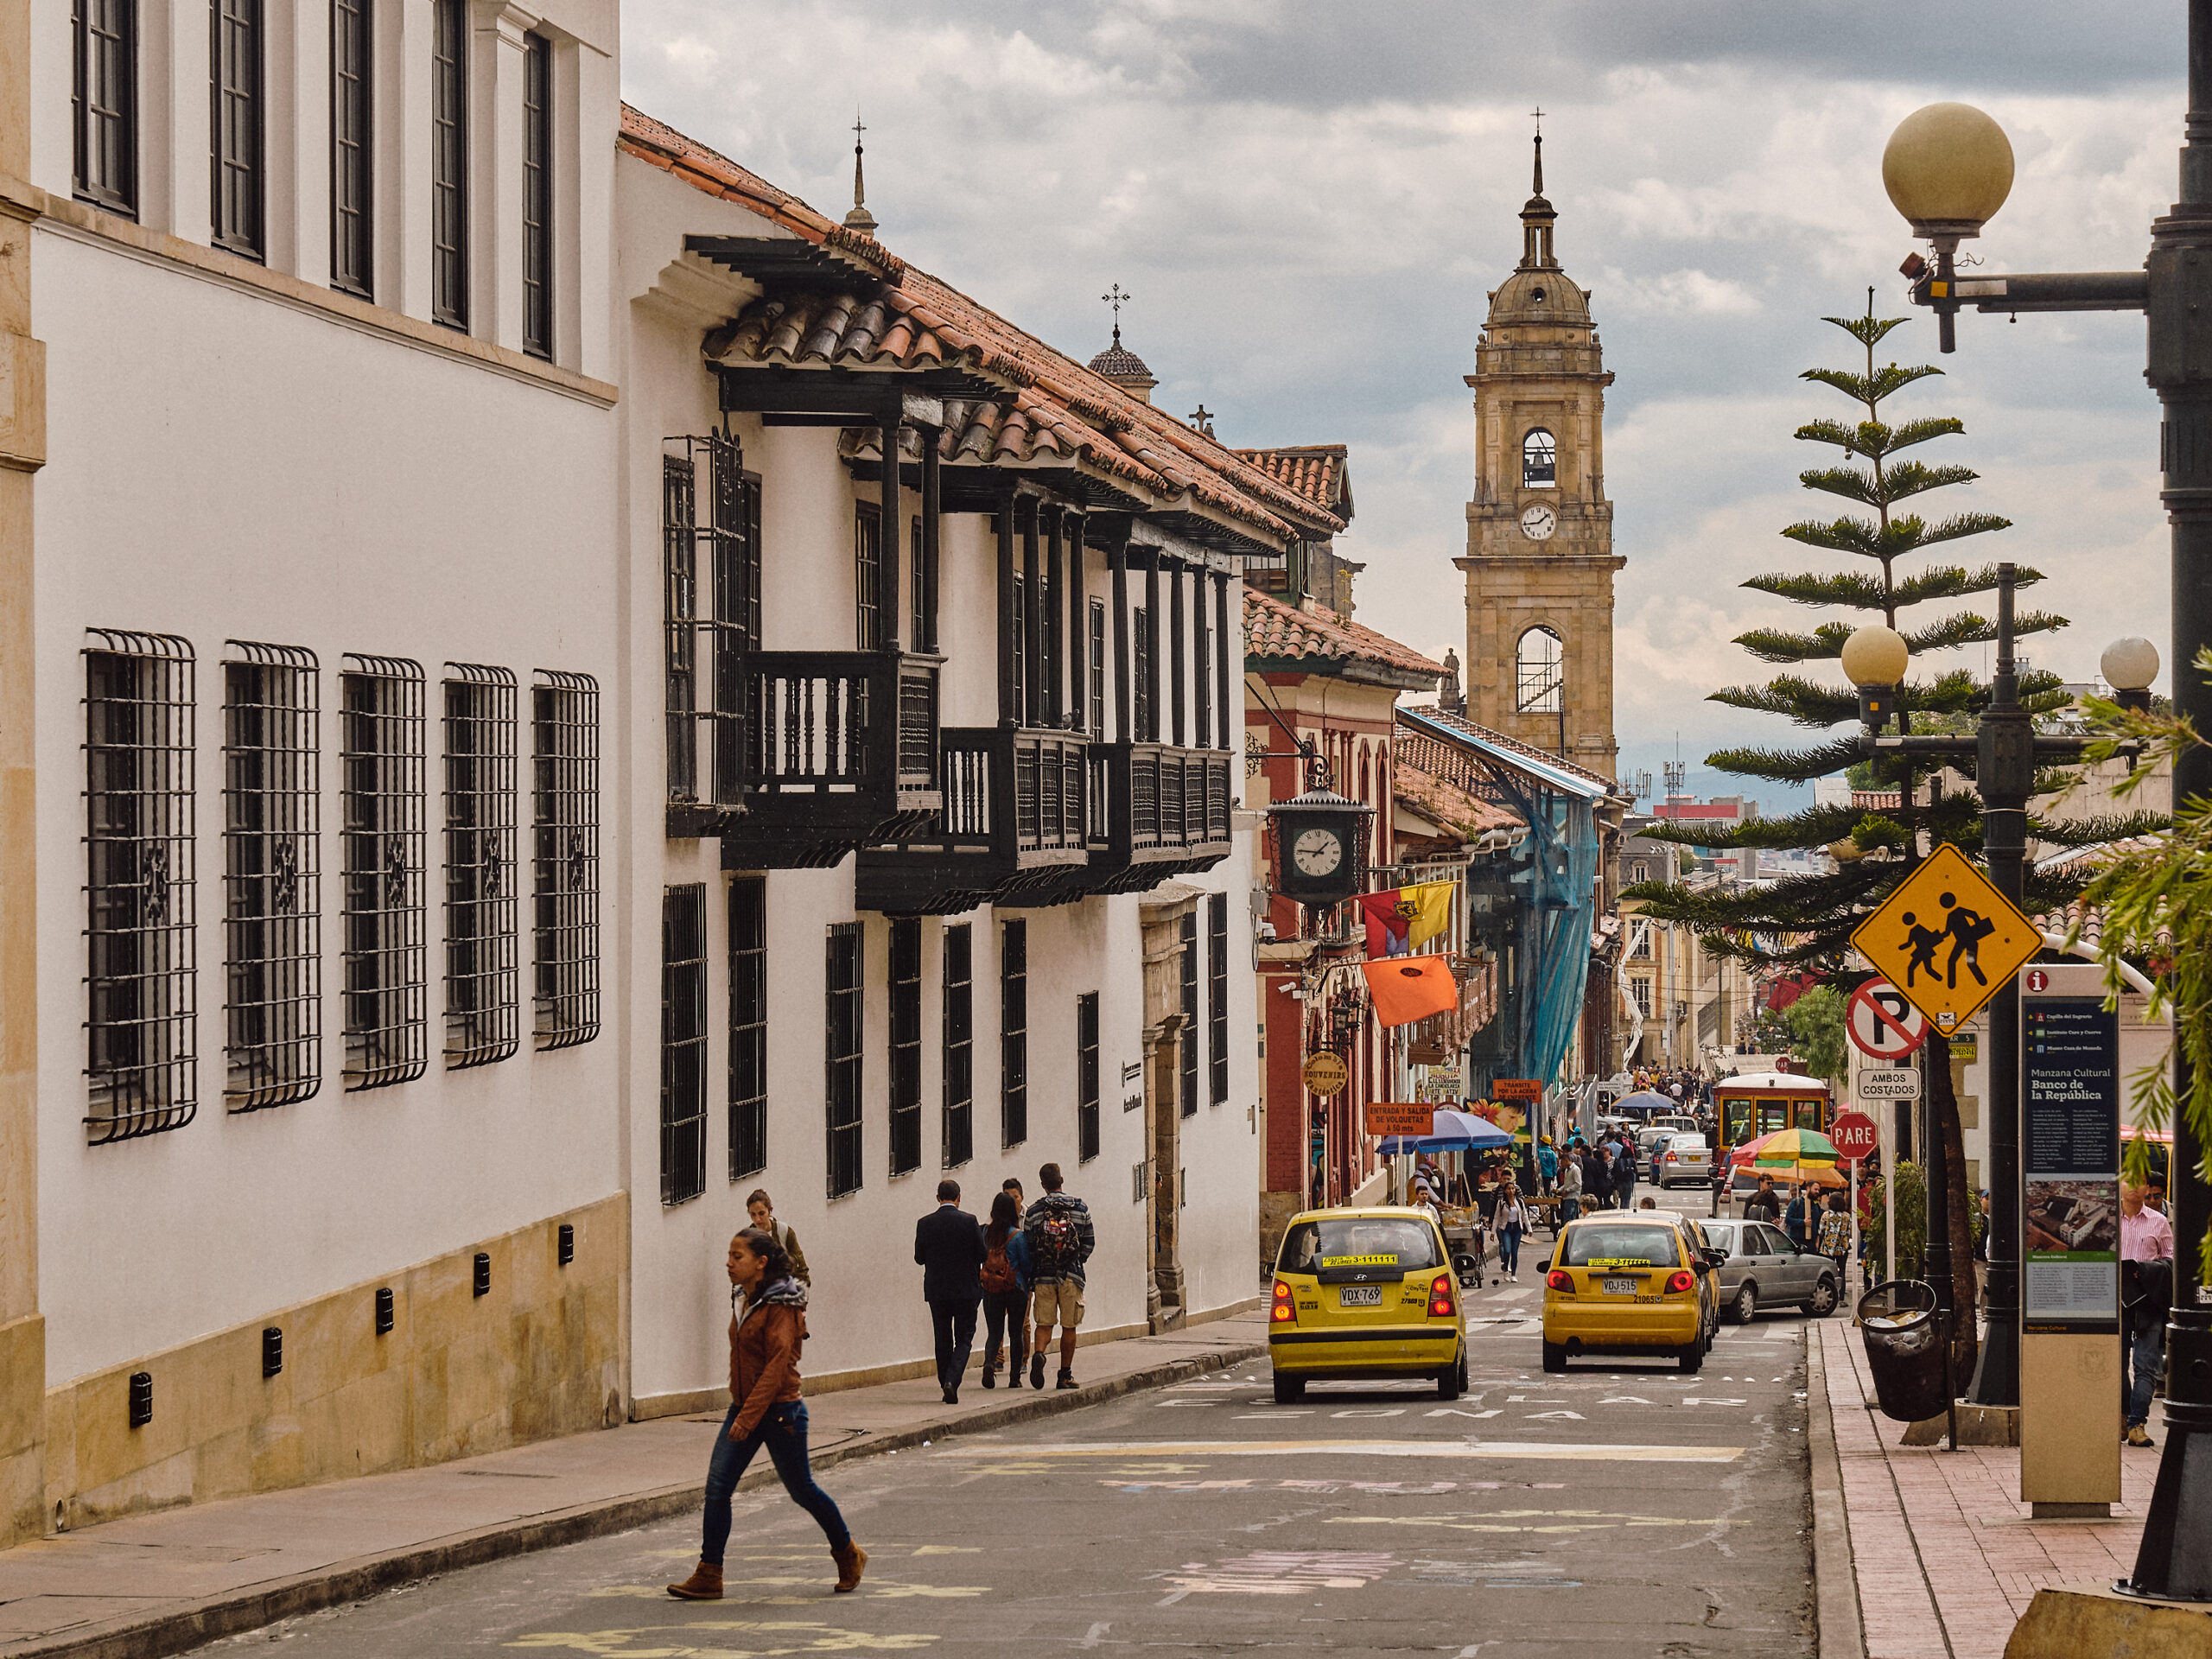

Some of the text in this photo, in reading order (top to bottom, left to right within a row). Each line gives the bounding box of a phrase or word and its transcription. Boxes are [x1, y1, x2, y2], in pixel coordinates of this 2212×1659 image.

[1872, 992, 1910, 1044] P
[2073, 1068, 2110, 1077] Cultural
[1872, 1074, 1906, 1083] AMBOS
[2031, 1079, 2083, 1089] Banco de
[1863, 1085, 1915, 1095] COSTADOS
[2031, 1090, 2102, 1102] la República
[1370, 1106, 1400, 1115] ENTRADA
[1407, 1106, 1430, 1115] SALIDA
[1834, 1127, 1872, 1145] PARE
[1633, 1295, 1655, 1304] 21065
